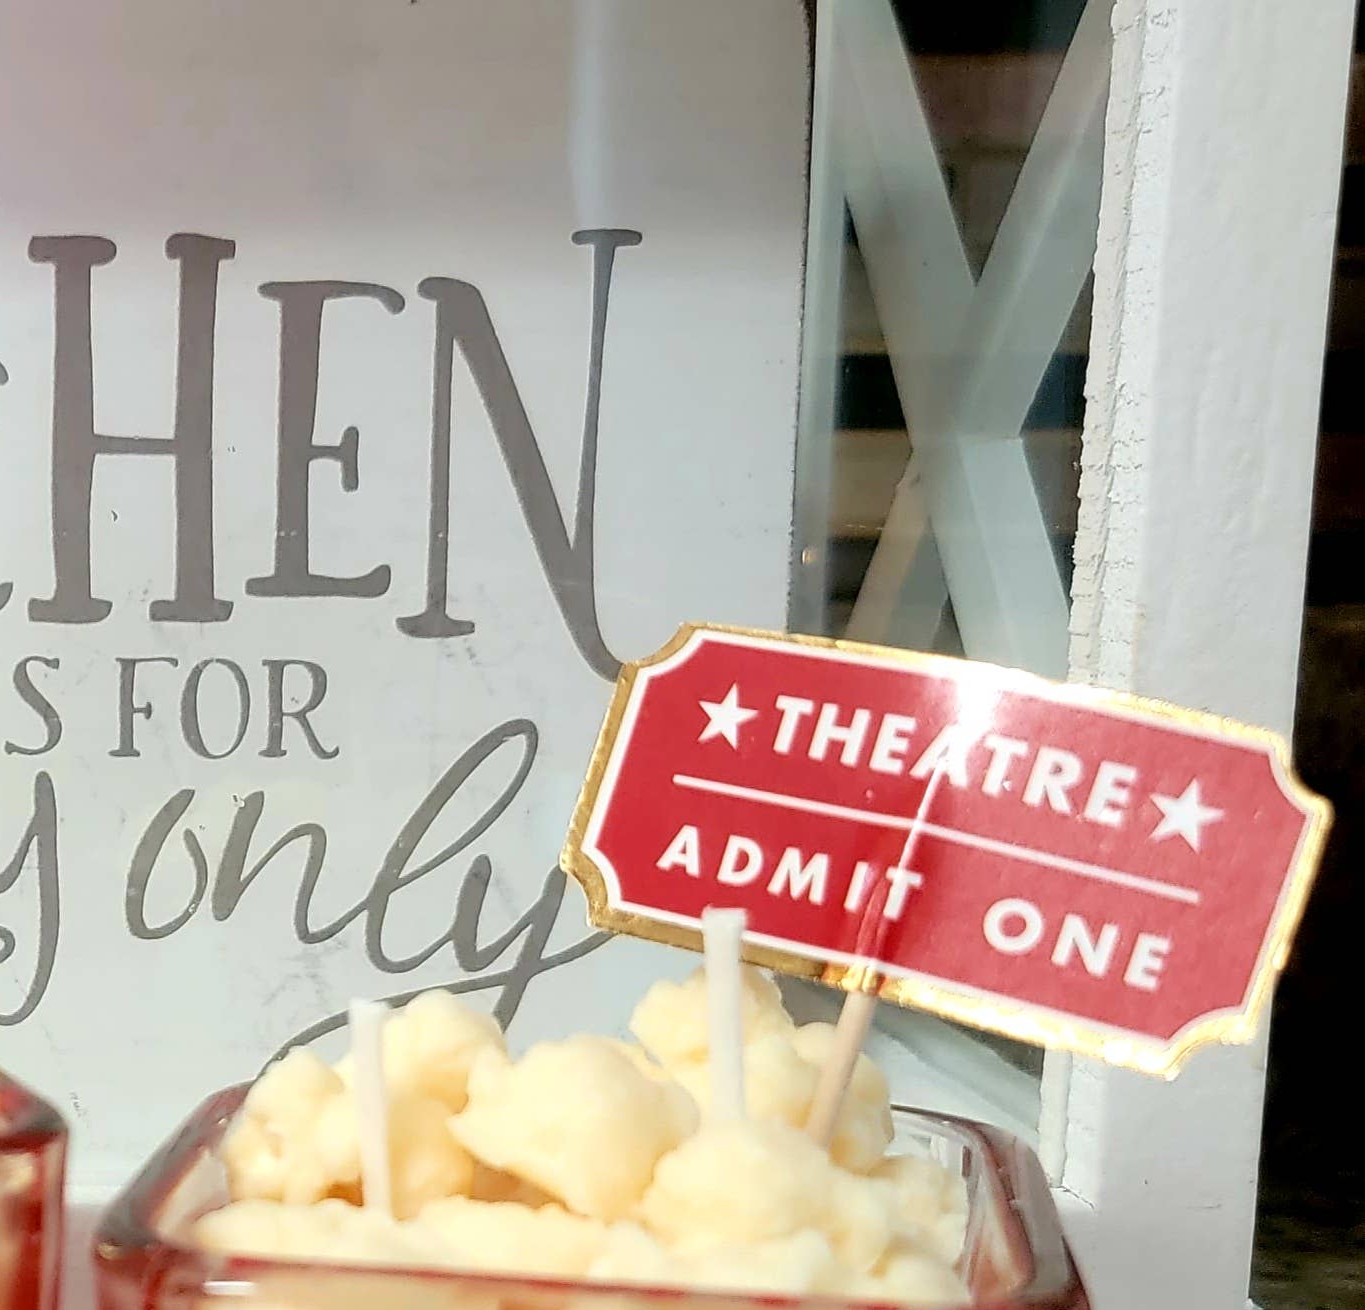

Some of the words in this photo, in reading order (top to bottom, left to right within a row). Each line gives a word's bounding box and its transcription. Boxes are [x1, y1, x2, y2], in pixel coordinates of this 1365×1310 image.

[107, 656, 340, 760] FOR
[770, 694, 1139, 829] THEATRE
[126, 718, 619, 1035] only
[656, 824, 925, 922] ADMIT
[983, 898, 1174, 991] ONE
